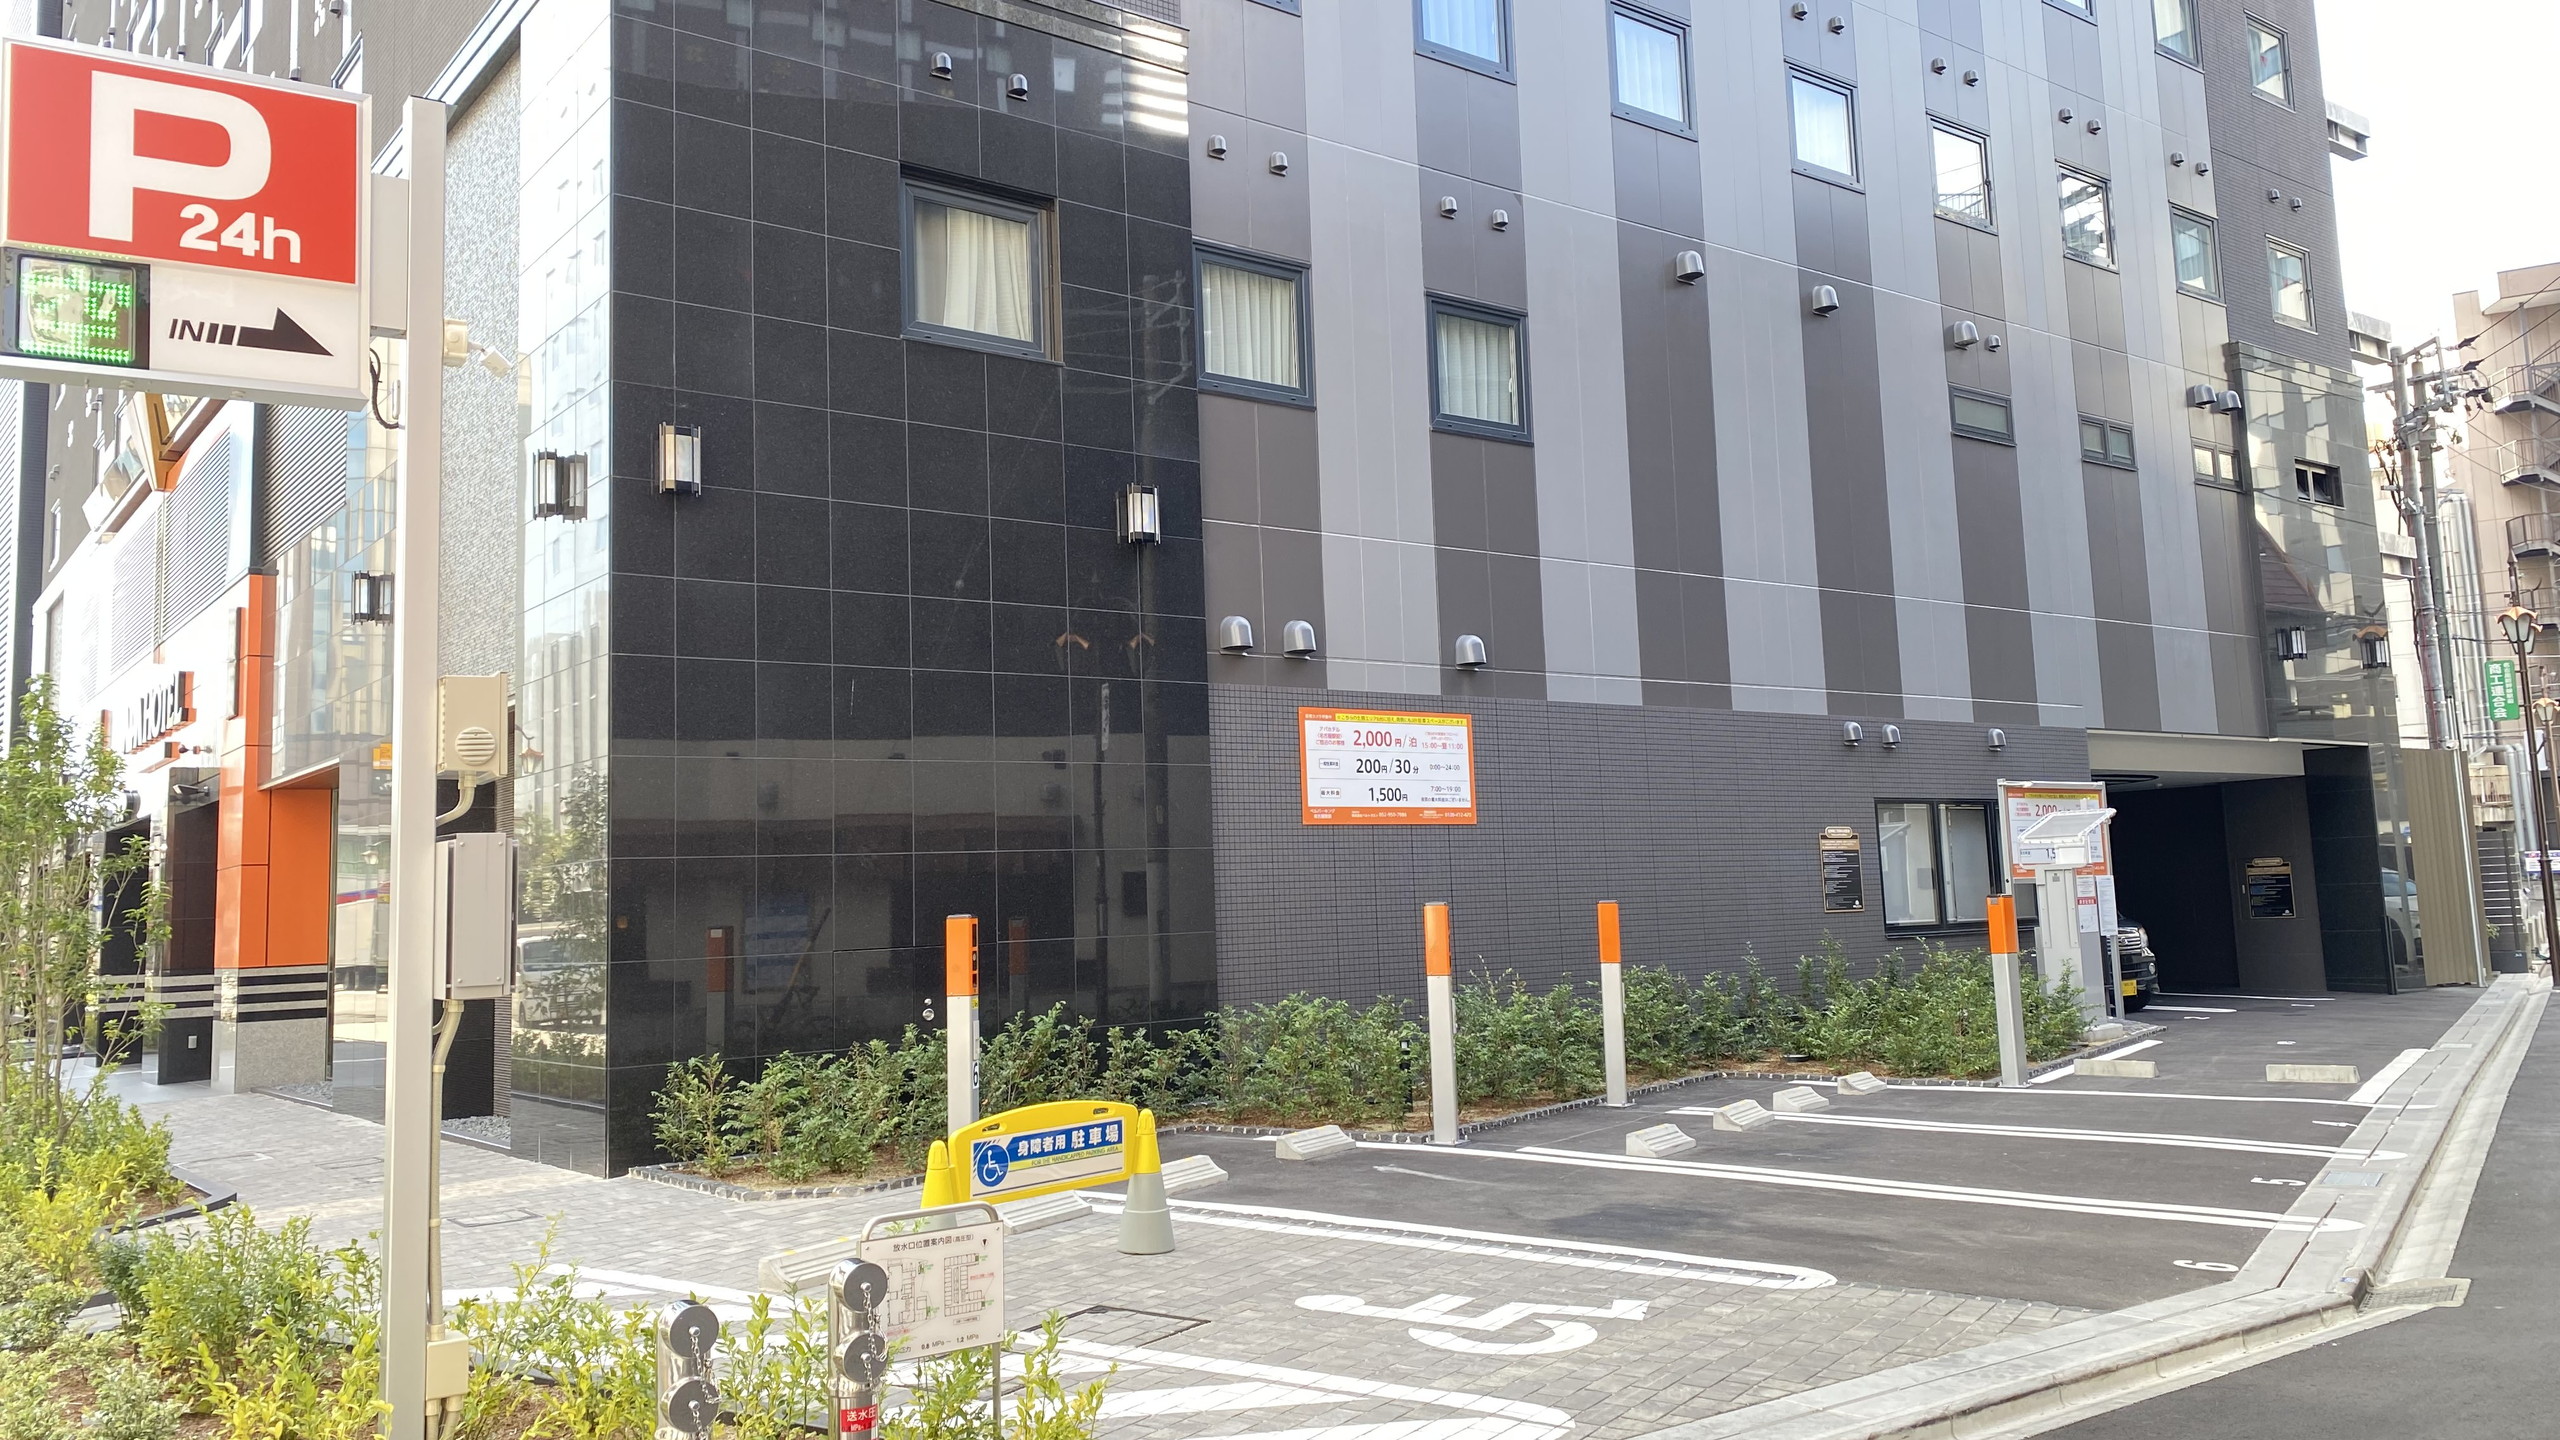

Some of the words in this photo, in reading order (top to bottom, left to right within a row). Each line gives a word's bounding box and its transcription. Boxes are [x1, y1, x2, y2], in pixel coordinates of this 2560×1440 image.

[88, 70, 272, 242] P
[179, 203, 301, 263] 24h
[169, 318, 203, 343] IN
[2488, 663, 2508, 718] 商工連合会
[1368, 787, 1408, 804] 1,500円
[1051, 1152, 1086, 1163] HANDICAPPED
